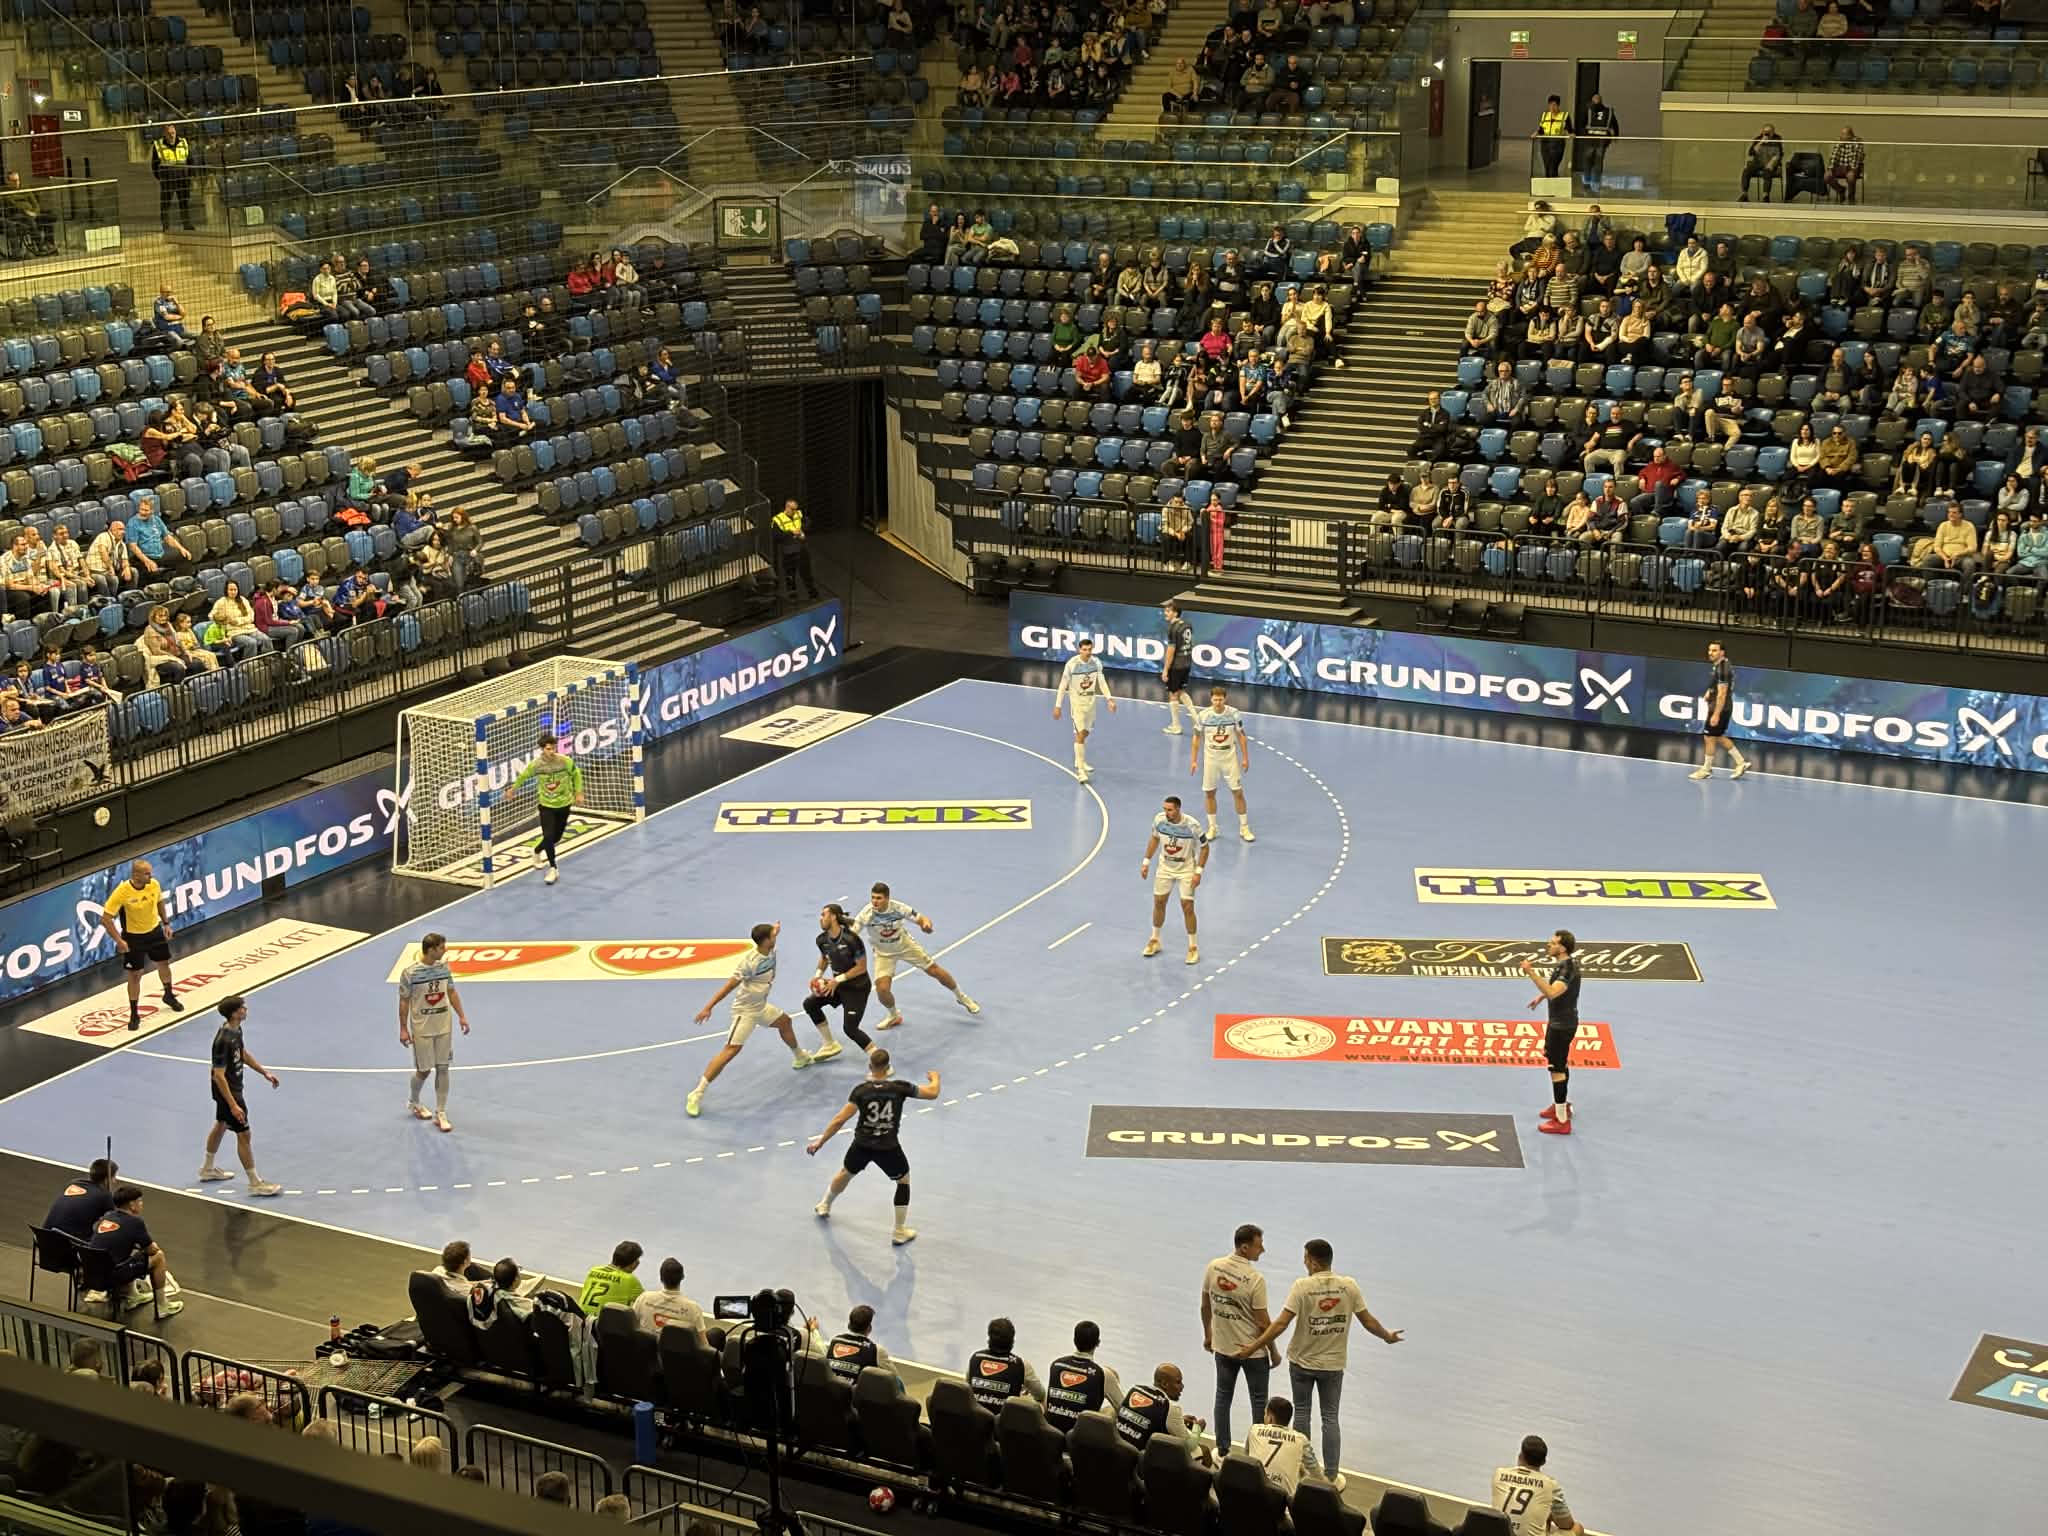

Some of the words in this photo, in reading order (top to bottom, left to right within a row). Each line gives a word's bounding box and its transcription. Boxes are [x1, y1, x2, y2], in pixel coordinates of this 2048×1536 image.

[1021, 625, 1250, 671] GRUNDOS
[660, 645, 808, 721] GRUNDFOS
[1317, 657, 1574, 706] GRUNDFOS
[1659, 694, 1949, 748] GUNDFOS
[438, 718, 618, 810] GRUNFOS
[444, 948, 526, 962] MOL
[609, 946, 697, 960] MOL
[1412, 965, 1501, 976] IMPERIAL
[1345, 1019, 1599, 1038] AVANTGAD
[1346, 1034, 1452, 1047] SPORT
[866, 1100, 894, 1123] 34
[1107, 1130, 1431, 1149] GRUNDFOS
[583, 1282, 610, 1307] 12
[1264, 1440, 1283, 1468] 7
[1502, 1486, 1534, 1516] 19
